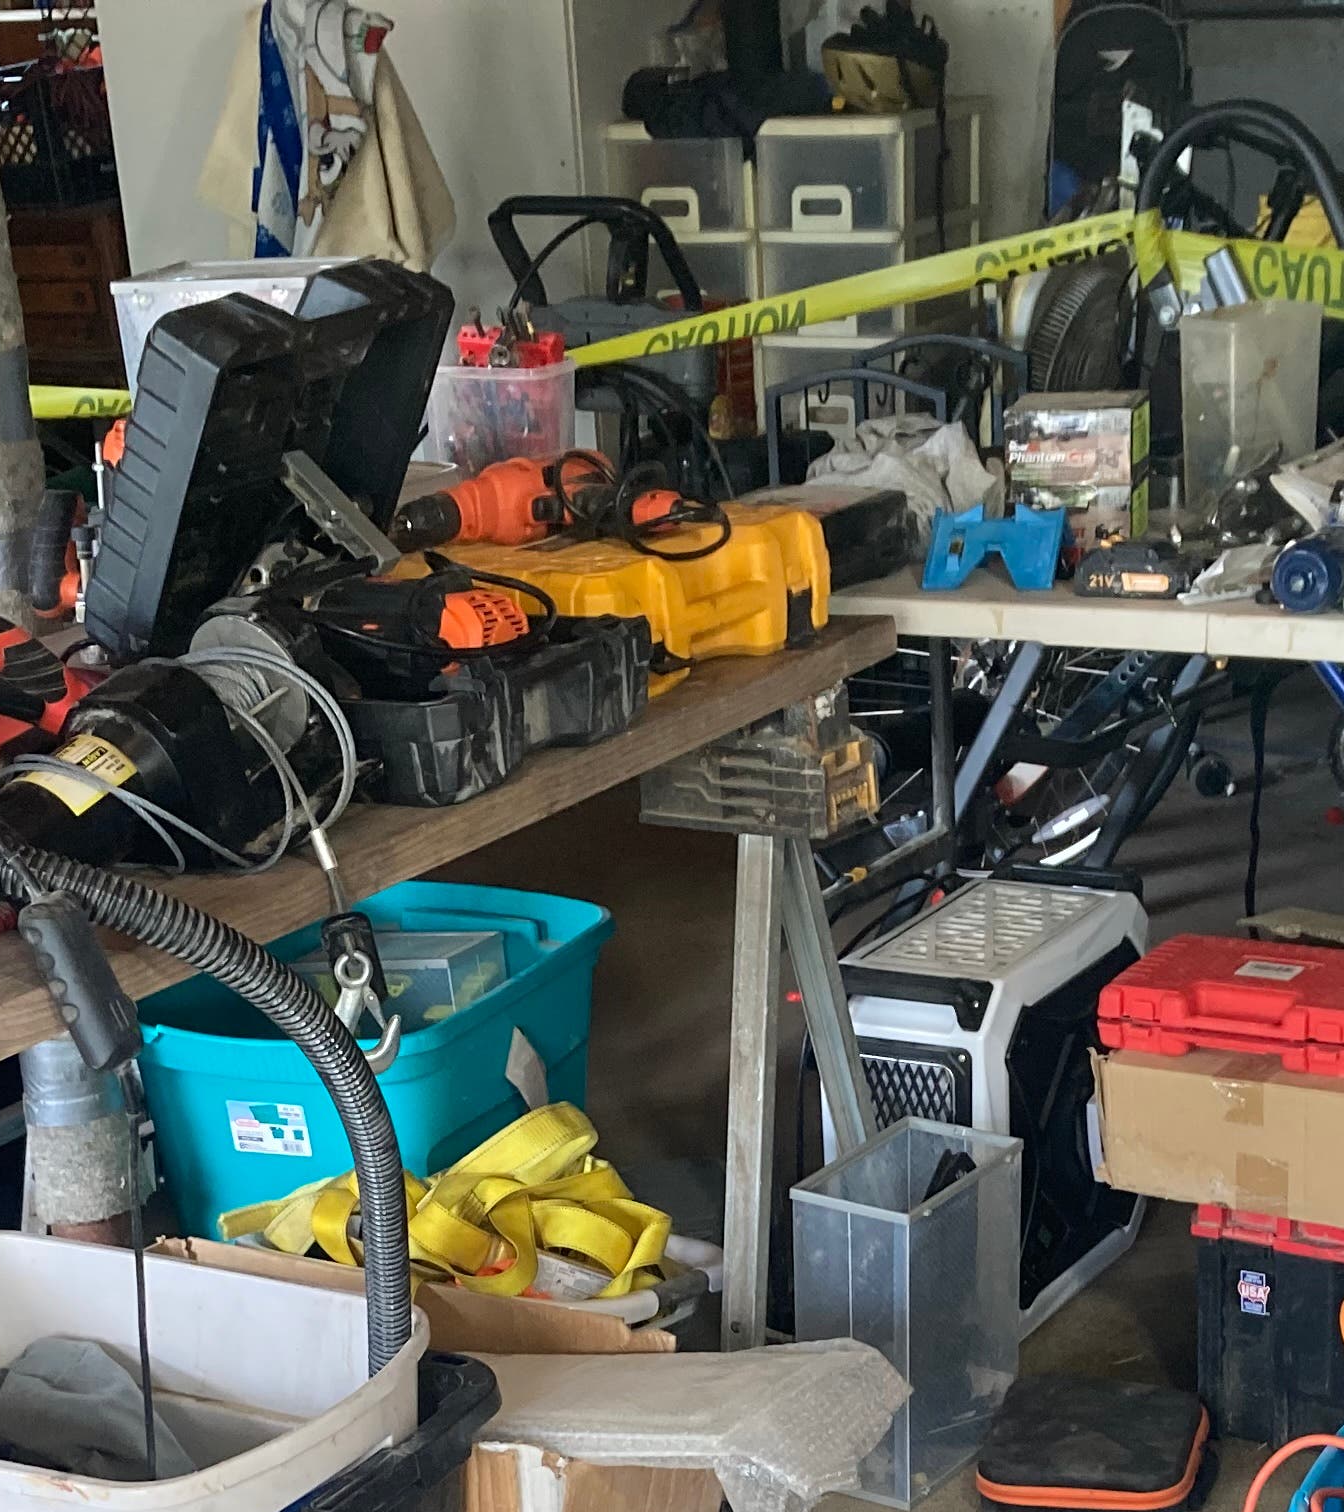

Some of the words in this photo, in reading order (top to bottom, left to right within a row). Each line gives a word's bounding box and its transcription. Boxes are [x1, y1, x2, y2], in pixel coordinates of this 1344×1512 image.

[1008, 451, 1065, 464] Phantom
[1089, 574, 1115, 588] 21V
[1241, 1283, 1266, 1299] USA
